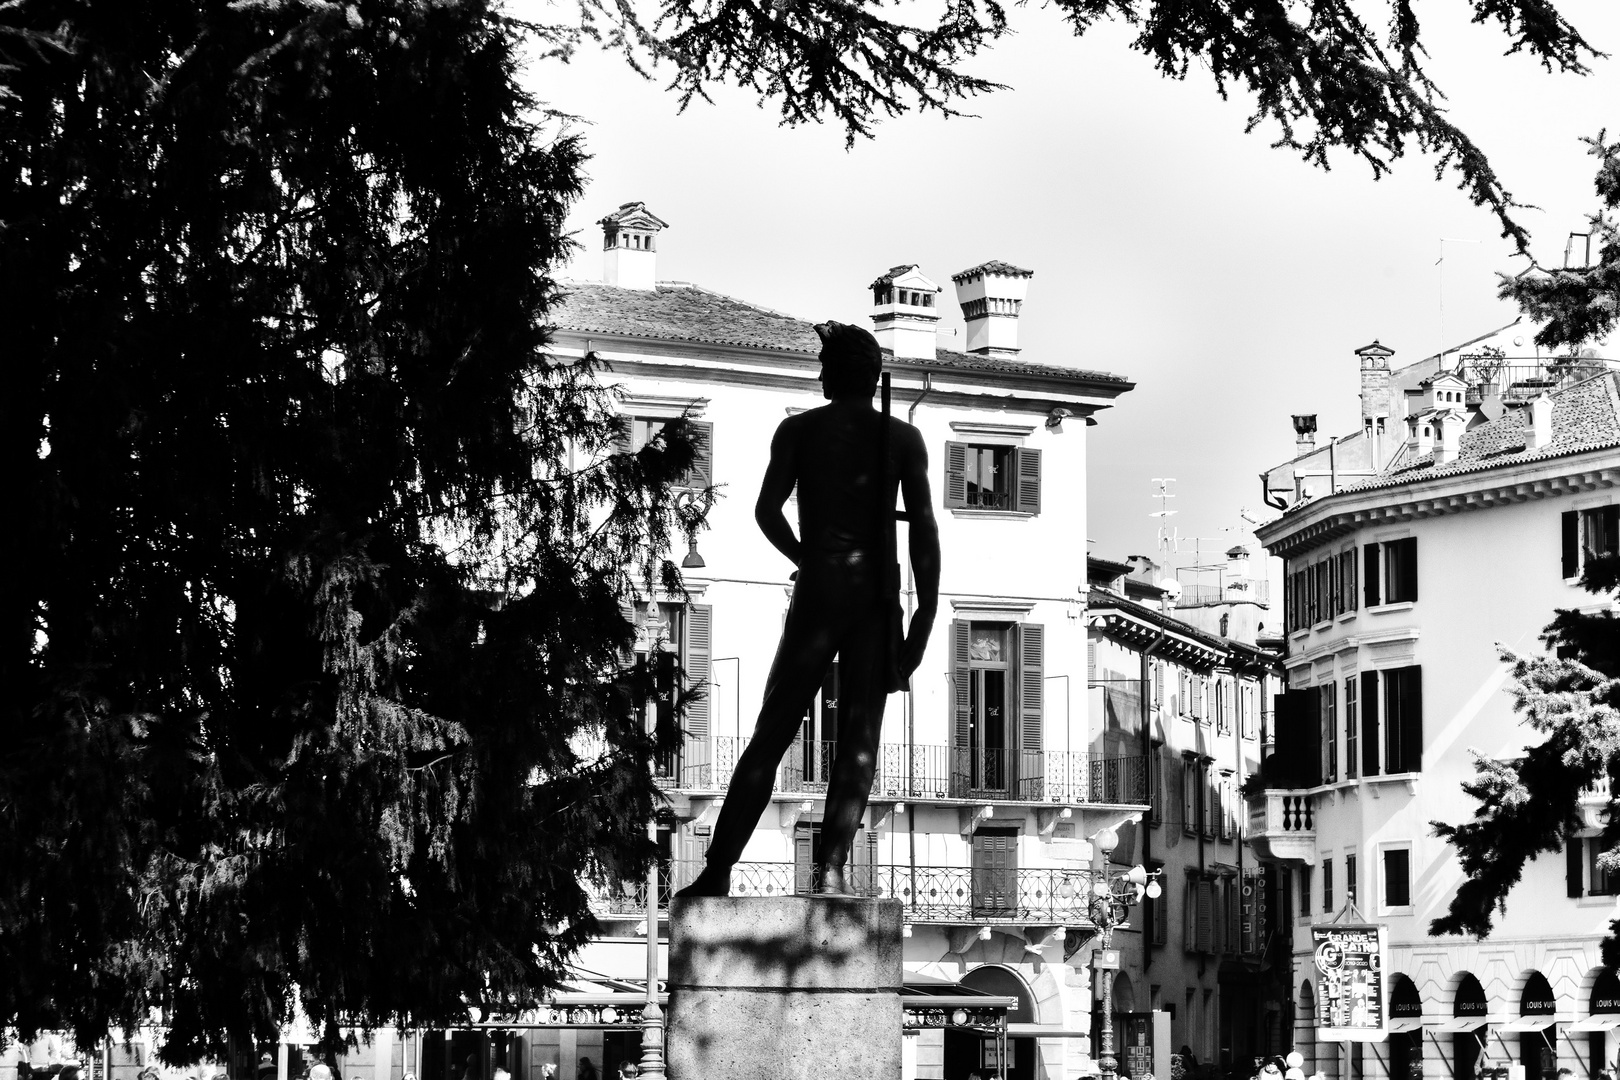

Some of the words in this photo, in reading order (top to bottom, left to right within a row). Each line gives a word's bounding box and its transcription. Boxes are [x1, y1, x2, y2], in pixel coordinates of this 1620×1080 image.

[1329, 934, 1367, 942] GRANDE
[1331, 941, 1379, 953] TEATRO
[1395, 1003, 1410, 1011] LOUIS
[1460, 1002, 1475, 1010] LOUIS
[1526, 1001, 1543, 1009] LOUIS
[1595, 1000, 1613, 1008] LOUIS
